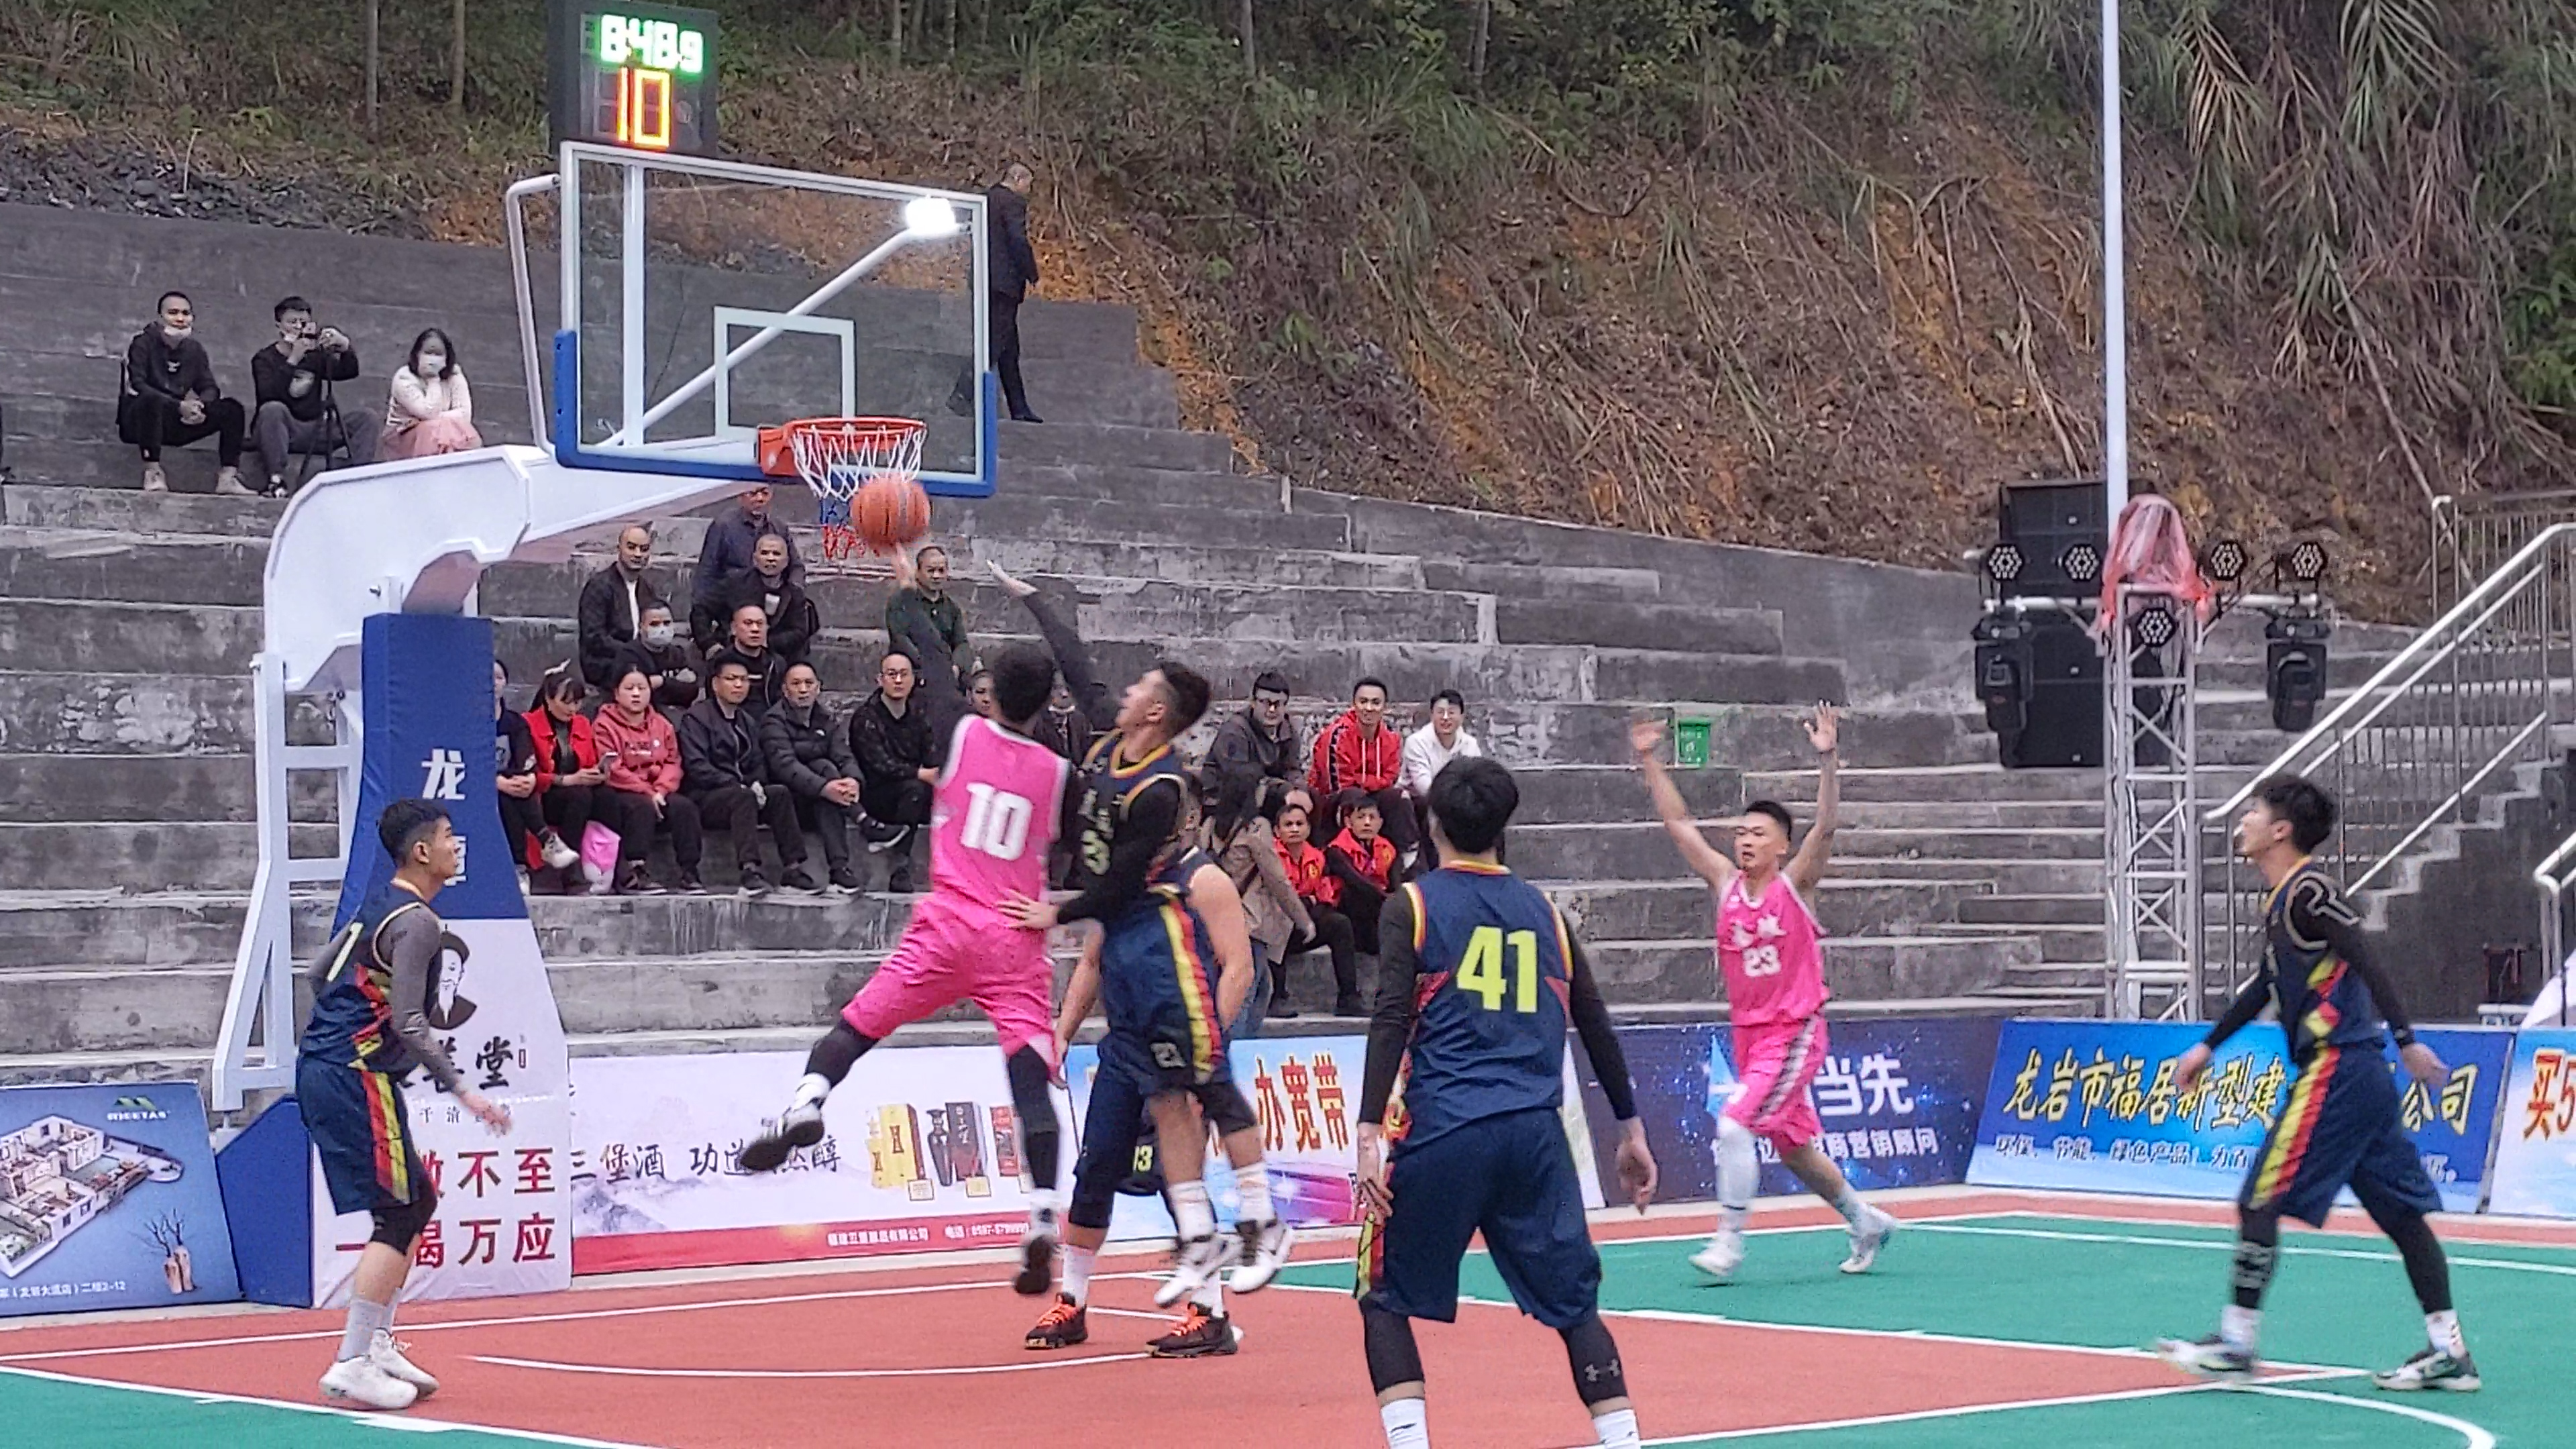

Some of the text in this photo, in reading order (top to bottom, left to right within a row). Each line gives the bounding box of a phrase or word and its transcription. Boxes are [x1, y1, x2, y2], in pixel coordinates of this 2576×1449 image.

[618, 66, 671, 148] 10
[959, 782, 1034, 861] 10
[1456, 926, 1538, 1013] 41
[1742, 944, 1782, 977] 23
[1210, 1055, 1350, 1155] 办宽带
